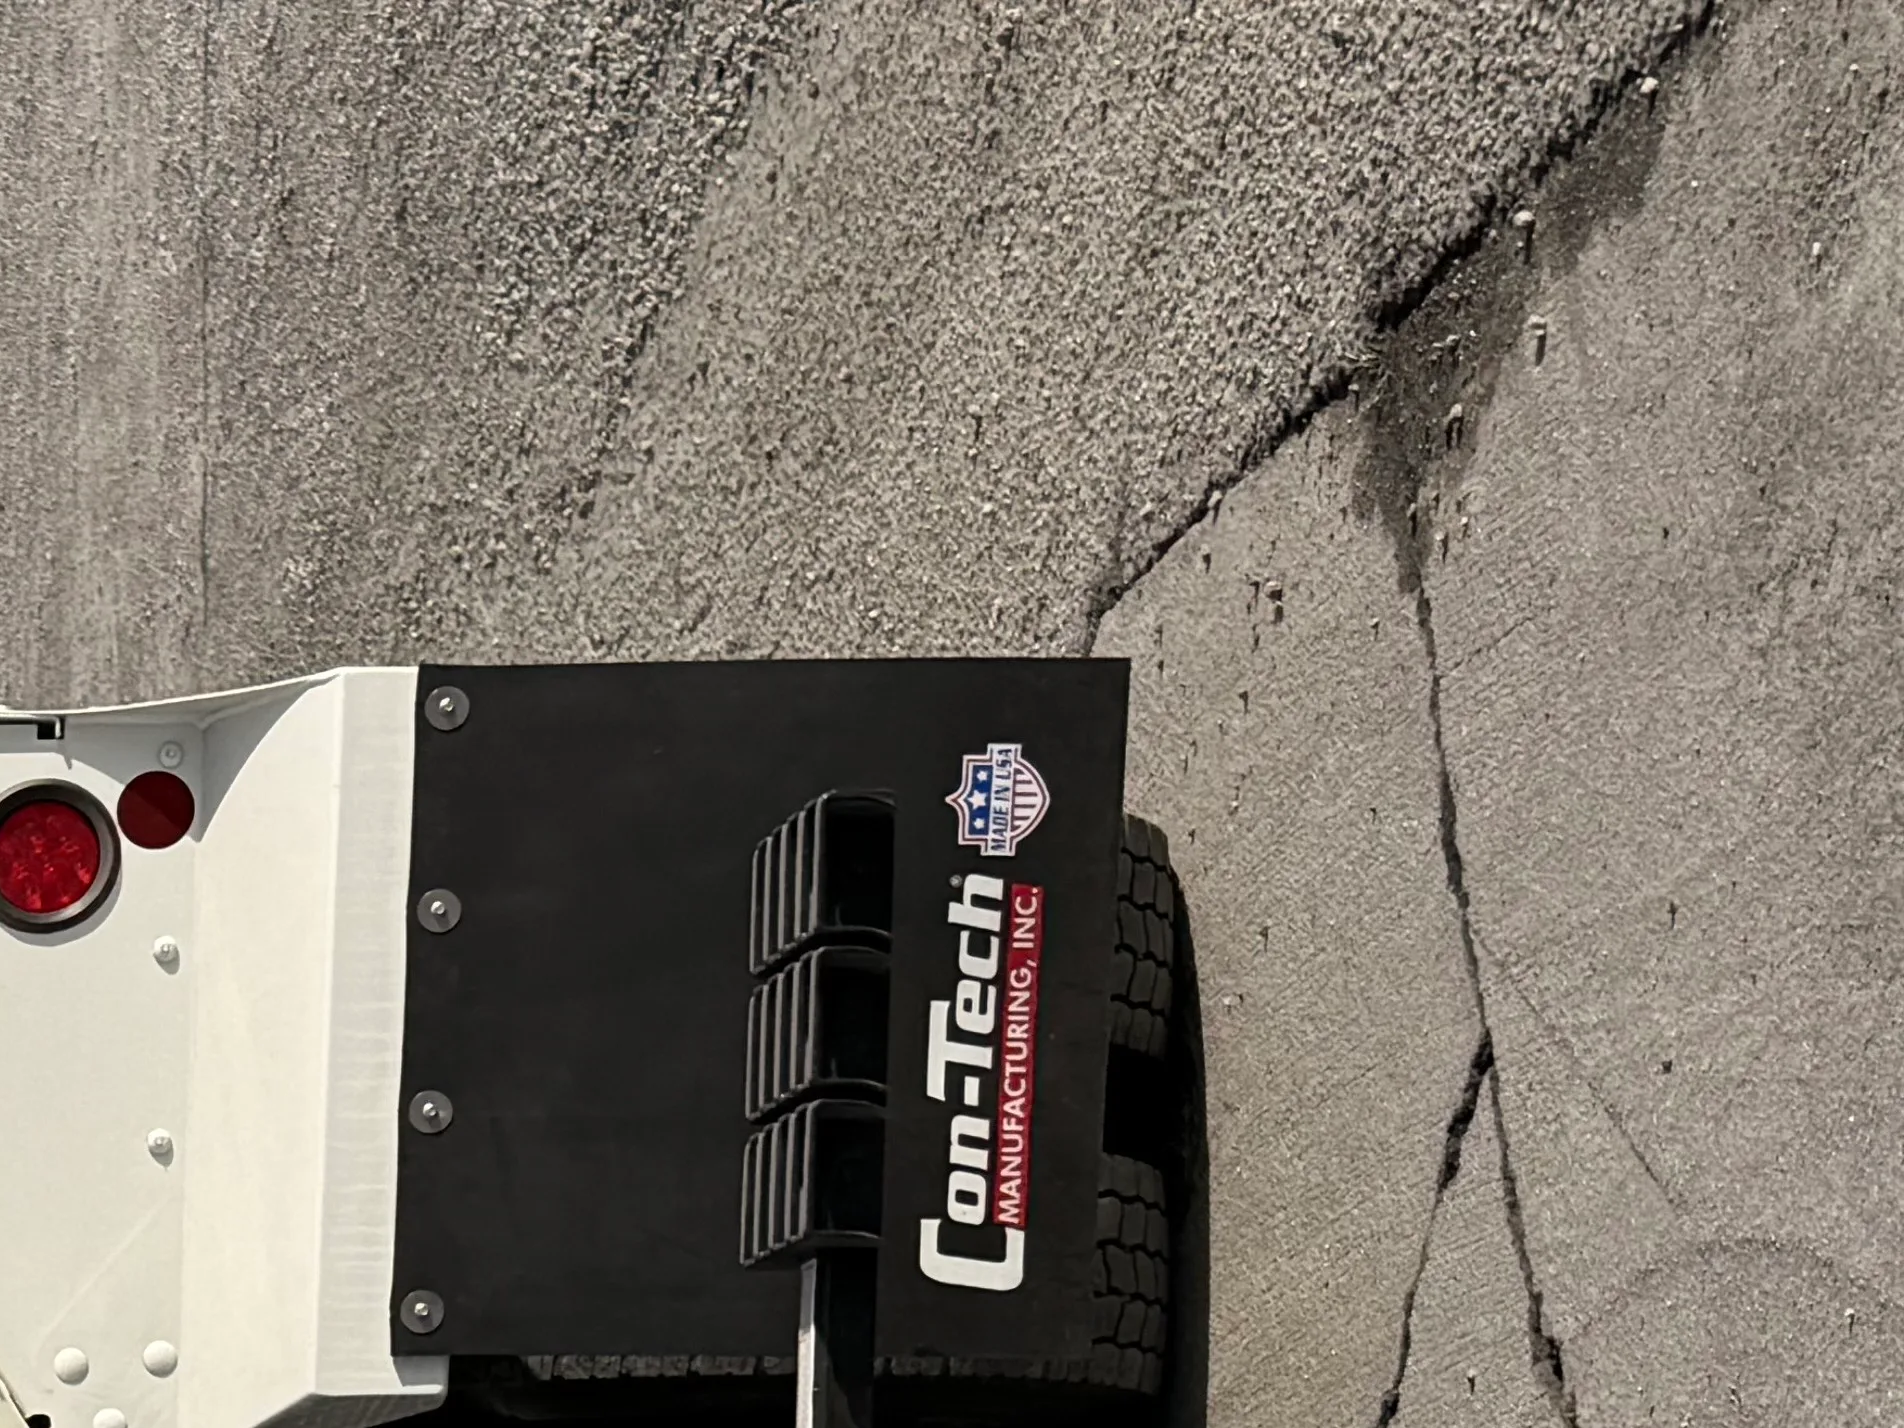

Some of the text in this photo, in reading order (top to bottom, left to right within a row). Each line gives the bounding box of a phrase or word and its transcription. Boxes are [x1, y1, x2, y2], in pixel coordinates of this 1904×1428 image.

[990, 748, 1012, 852] MADE IN USA
[998, 886, 1039, 1224] MANUFACTURING, INC.
